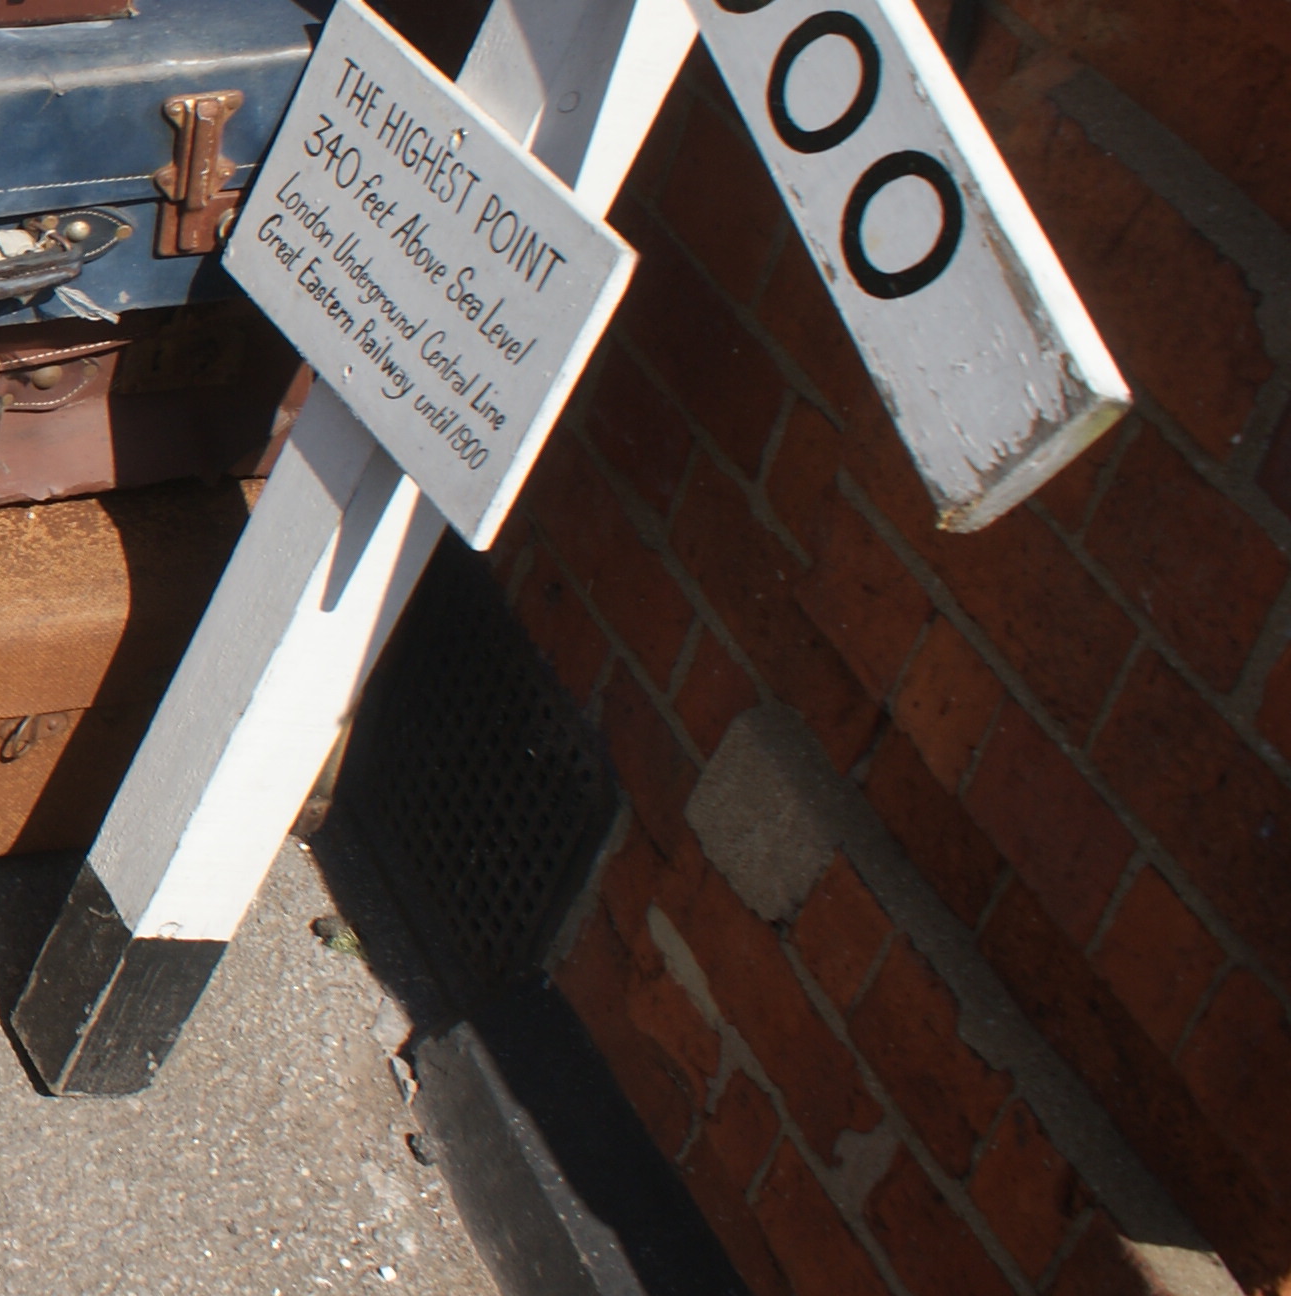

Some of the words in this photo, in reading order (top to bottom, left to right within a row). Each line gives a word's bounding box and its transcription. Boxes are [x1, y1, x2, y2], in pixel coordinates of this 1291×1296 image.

[275, 171, 335, 249] London
[332, 231, 429, 341] Underground
[420, 330, 481, 397] Central
[469, 381, 507, 432] Line
[303, 113, 362, 190] 340
[389, 212, 448, 285] Above
[445, 266, 485, 322] Sea
[477, 297, 538, 366] Level
[335, 56, 385, 129] THE
[376, 102, 482, 215] HIGHEST
[473, 193, 568, 293] POINT
[257, 213, 306, 272] Great
[297, 256, 367, 335] Eastern
[352, 317, 416, 400] Railway
[413, 394, 460, 435] until
[446, 423, 490, 471] 1900
